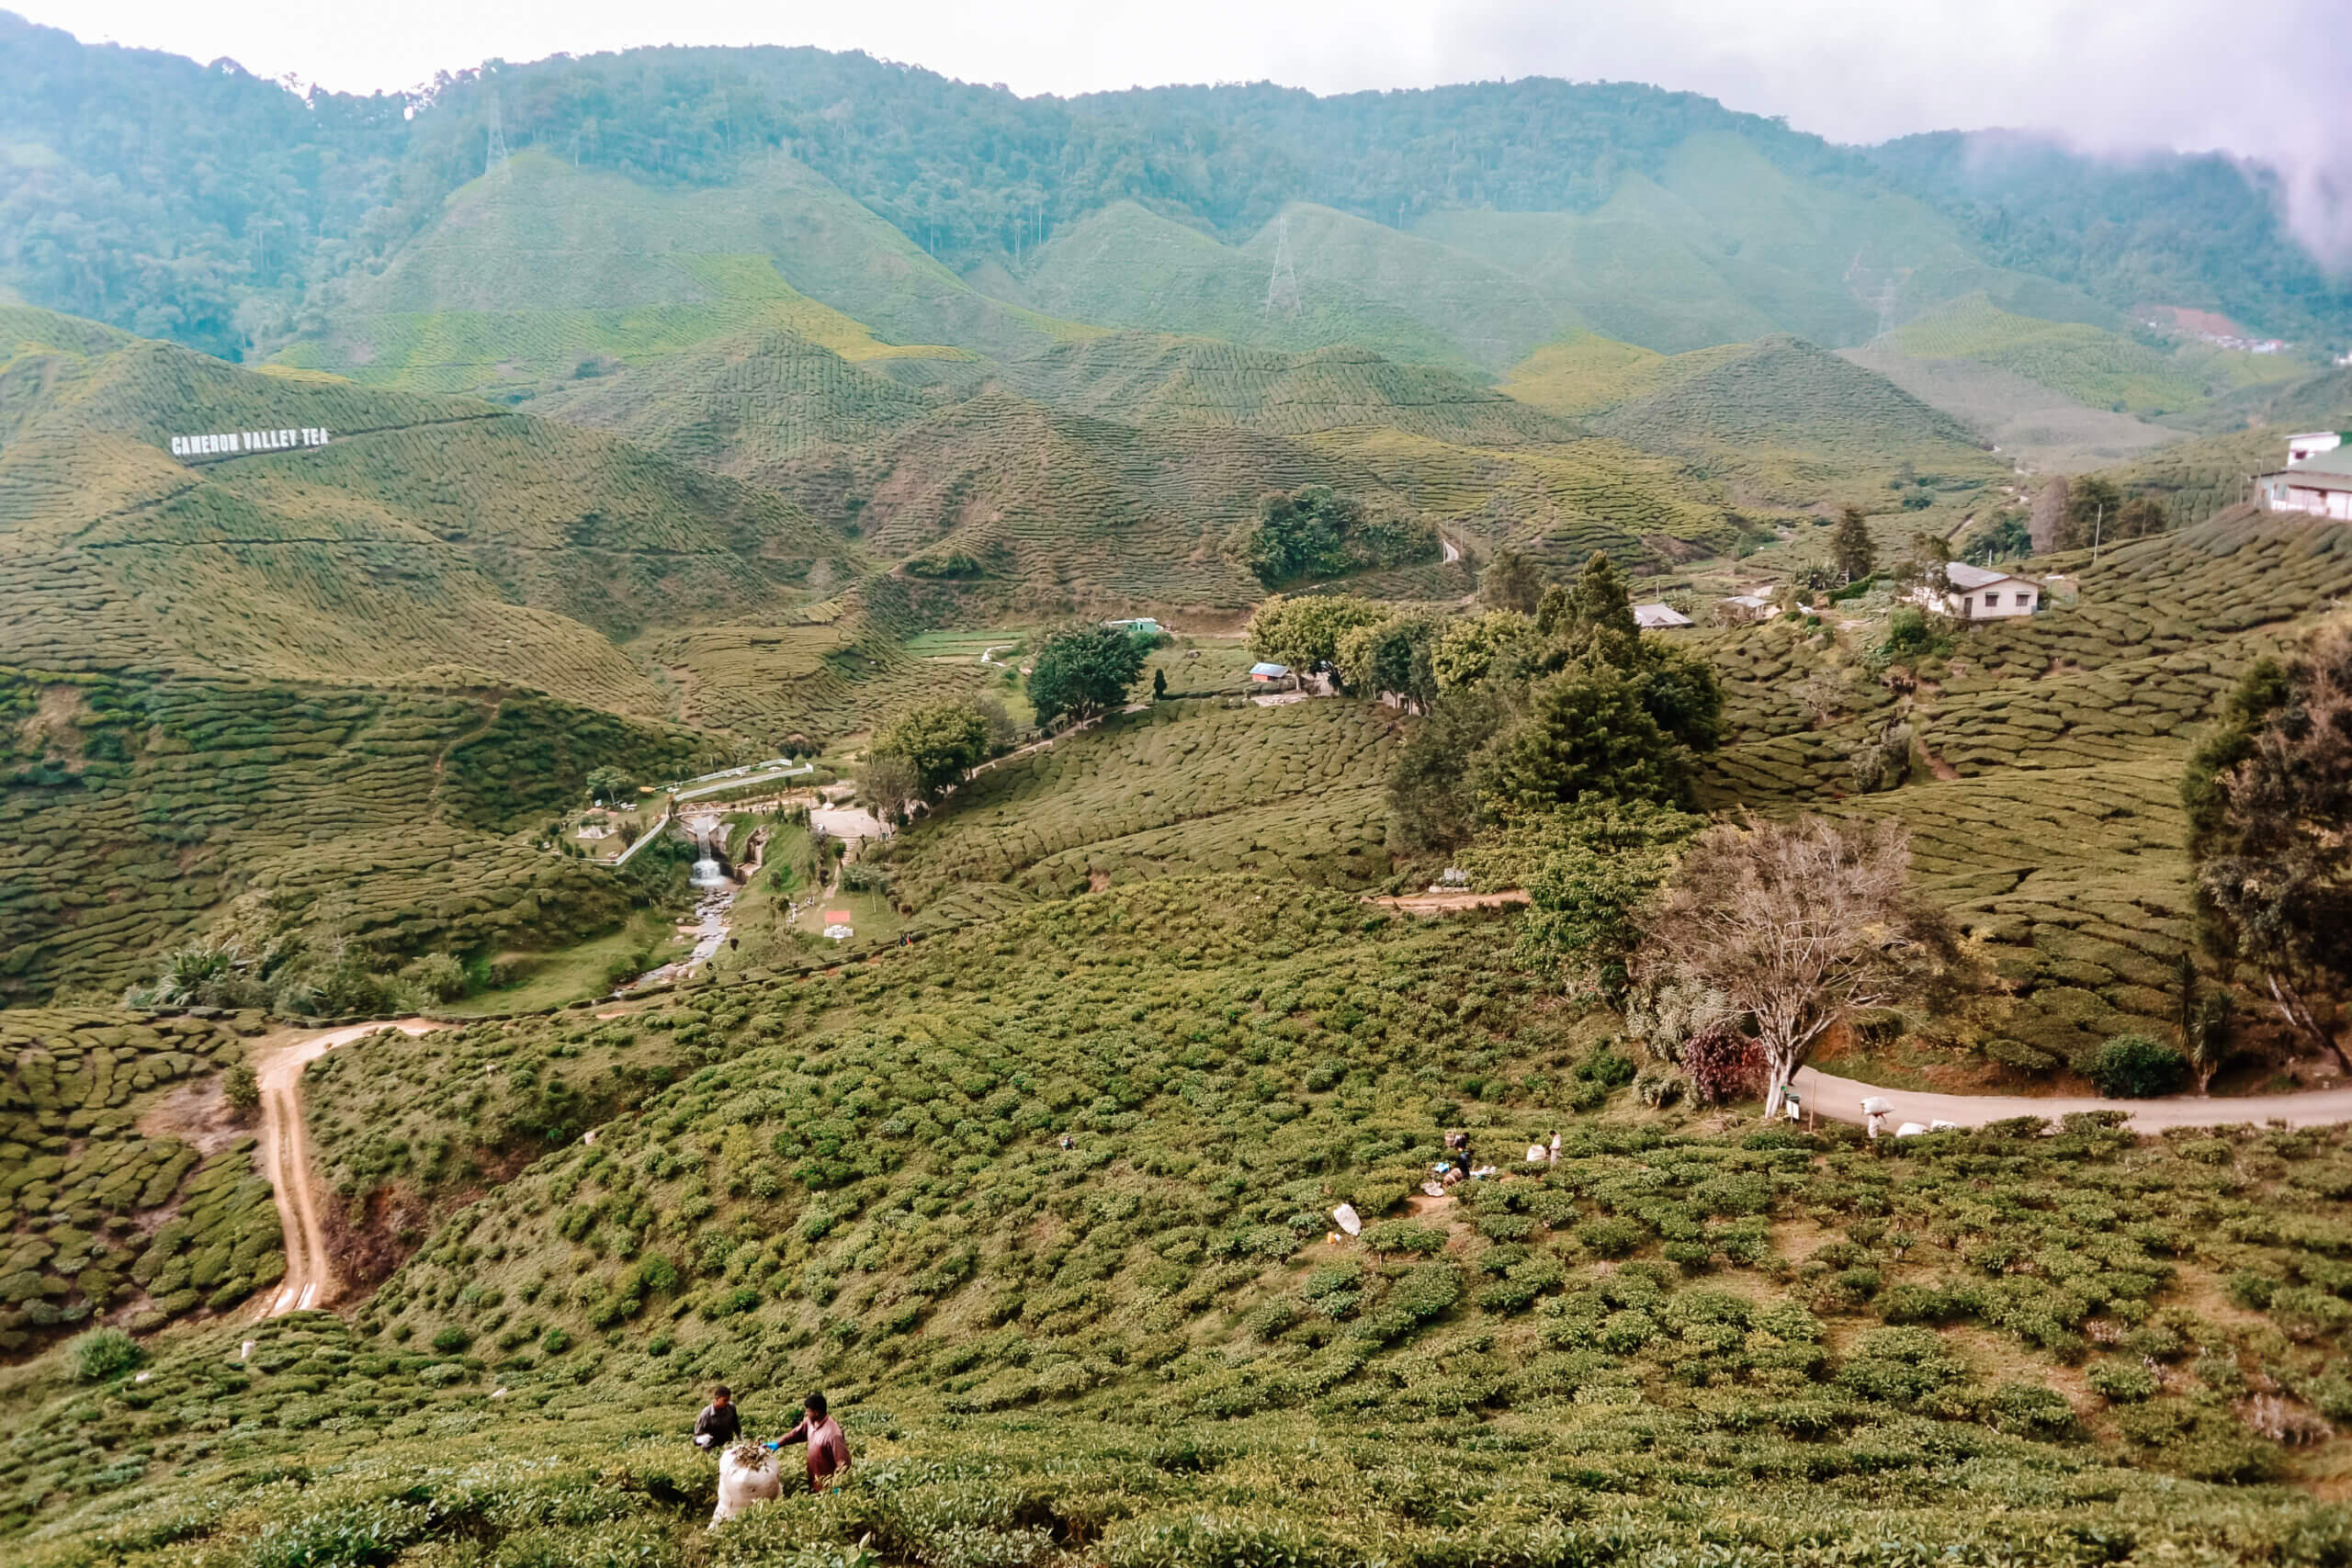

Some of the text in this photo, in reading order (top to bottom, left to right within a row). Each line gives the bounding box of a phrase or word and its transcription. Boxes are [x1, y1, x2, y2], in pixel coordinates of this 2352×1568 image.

[171, 427, 329, 455] CAMERON VALLEY TEA
